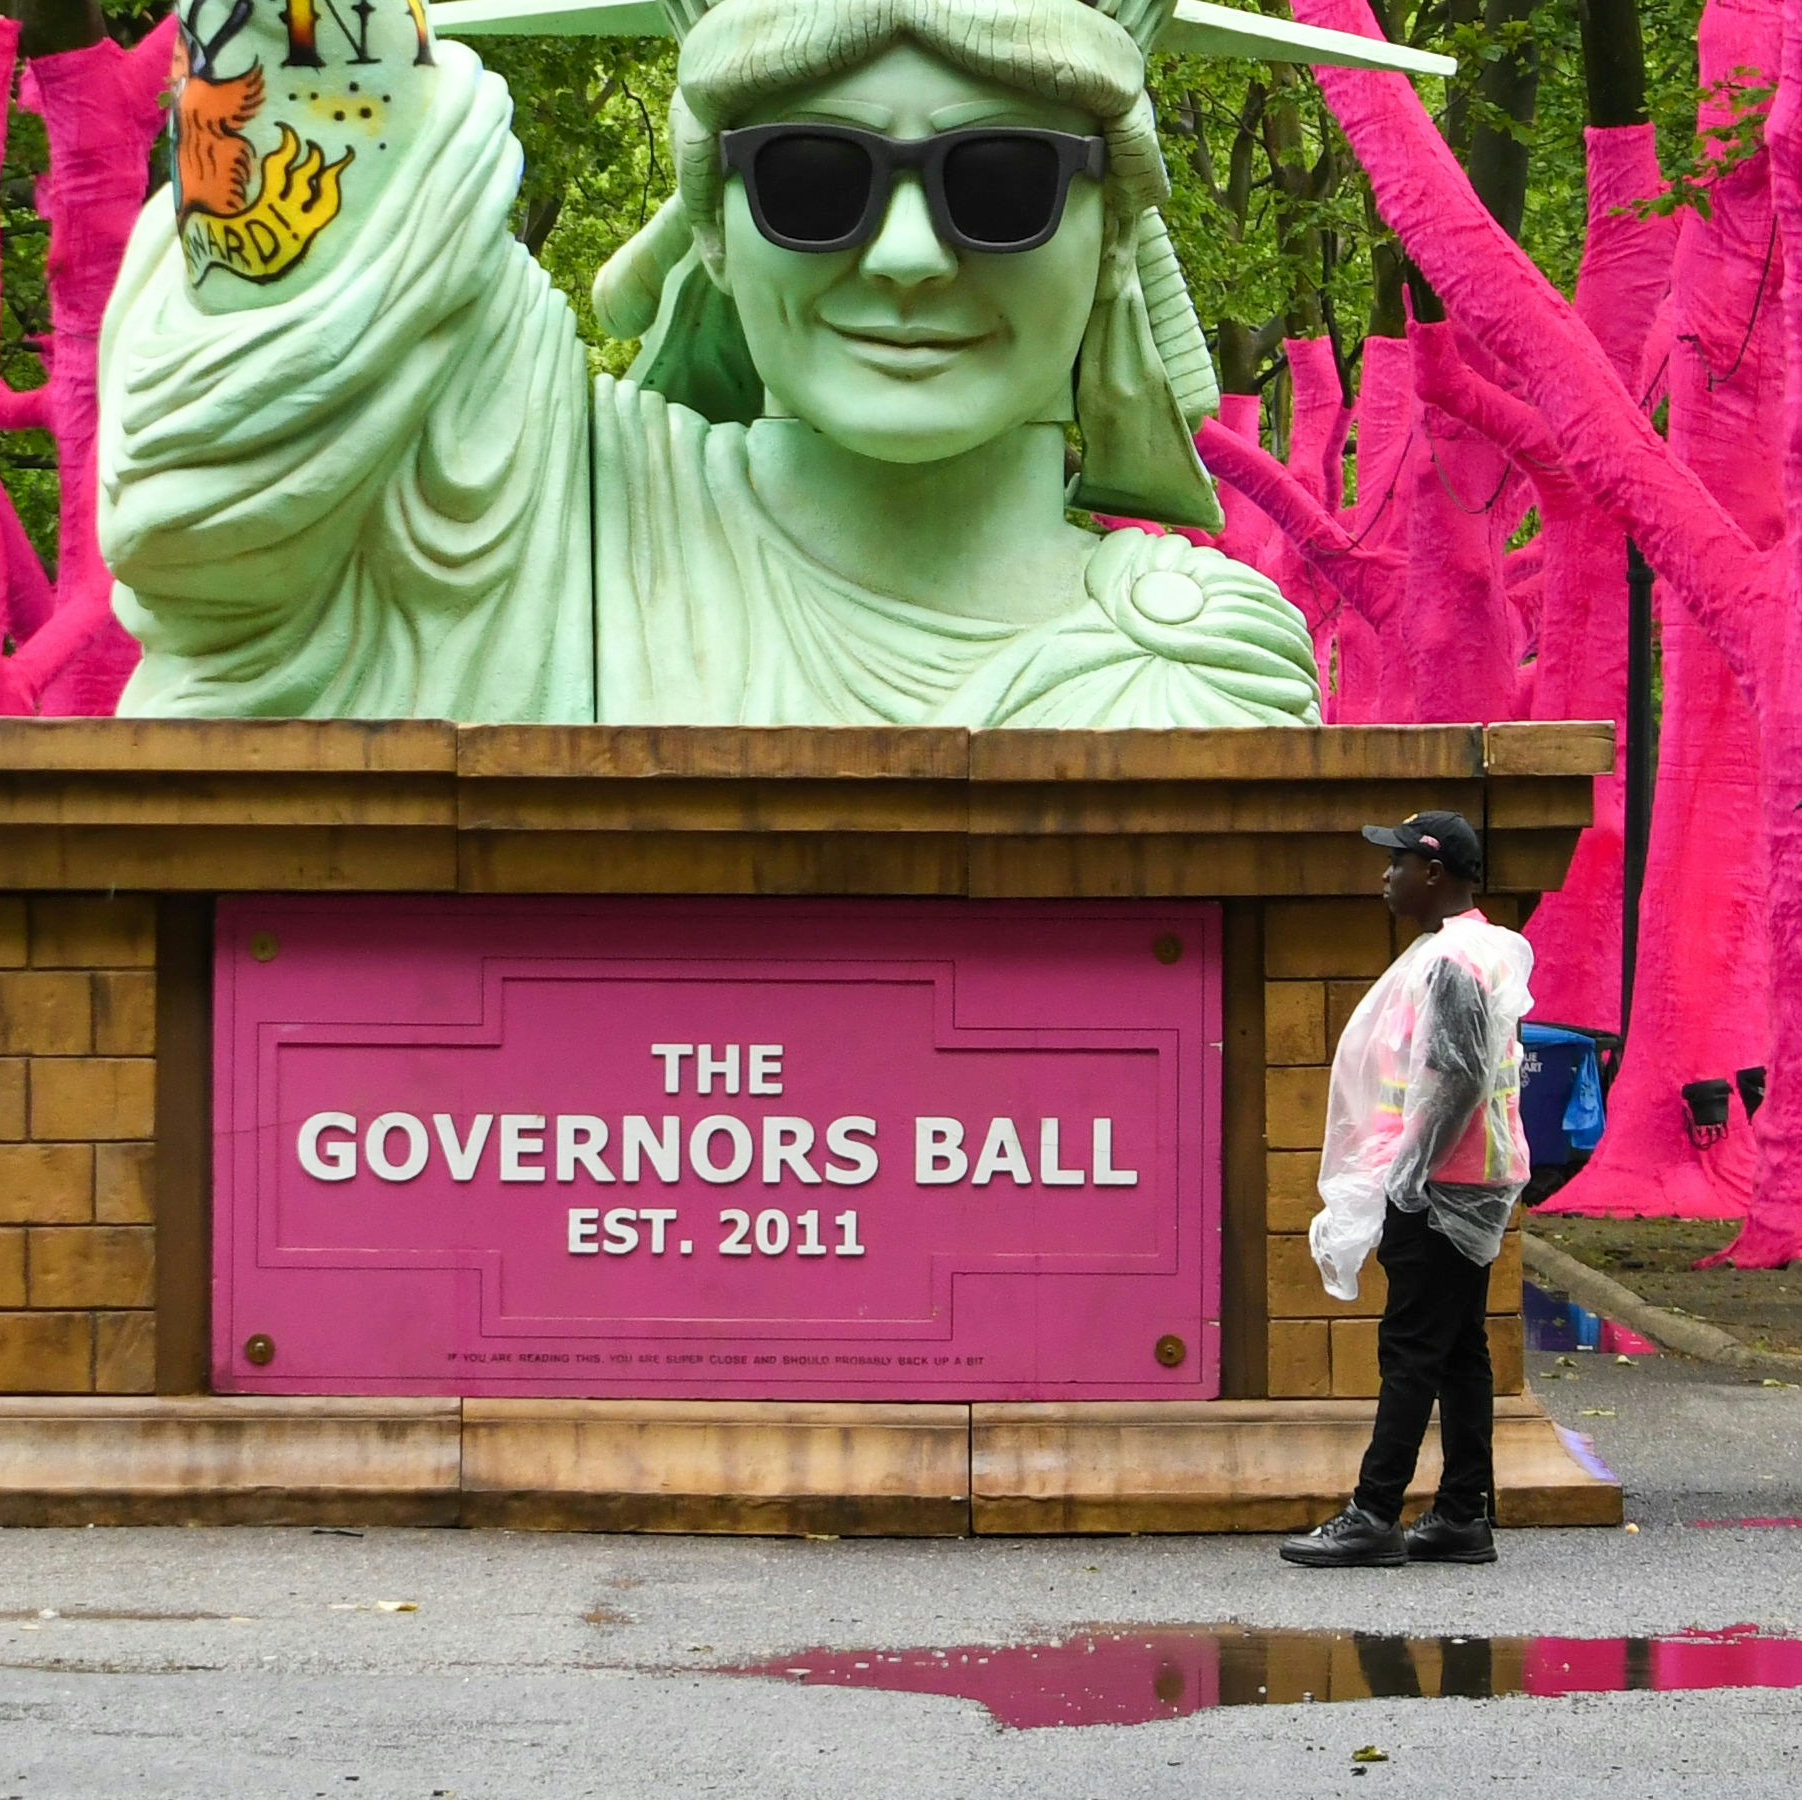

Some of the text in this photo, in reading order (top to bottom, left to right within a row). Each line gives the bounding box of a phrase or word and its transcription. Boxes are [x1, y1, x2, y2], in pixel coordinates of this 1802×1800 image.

[650, 1043, 785, 1096] THE
[1522, 1062, 1544, 1073] ART
[296, 1110, 1139, 1187] GOVERNORS BALL
[566, 1207, 867, 1256] EST. 2011
[447, 1353, 459, 1362] IF
[462, 1353, 487, 1364] YOU
[491, 1353, 513, 1363] ARE
[518, 1353, 570, 1364] READING
[609, 1354, 633, 1365] YOU
[637, 1354, 660, 1365] ARE
[665, 1354, 704, 1365] SUPER
[708, 1355, 748, 1365] CLOSE
[753, 1356, 777, 1366] AND
[782, 1356, 830, 1366] SHOULD
[834, 1356, 892, 1367] PROBABLY
[897, 1357, 929, 1367] BACK
[933, 1357, 950, 1367] UP
[953, 1357, 962, 1366] A
[966, 1356, 985, 1367] BIT
